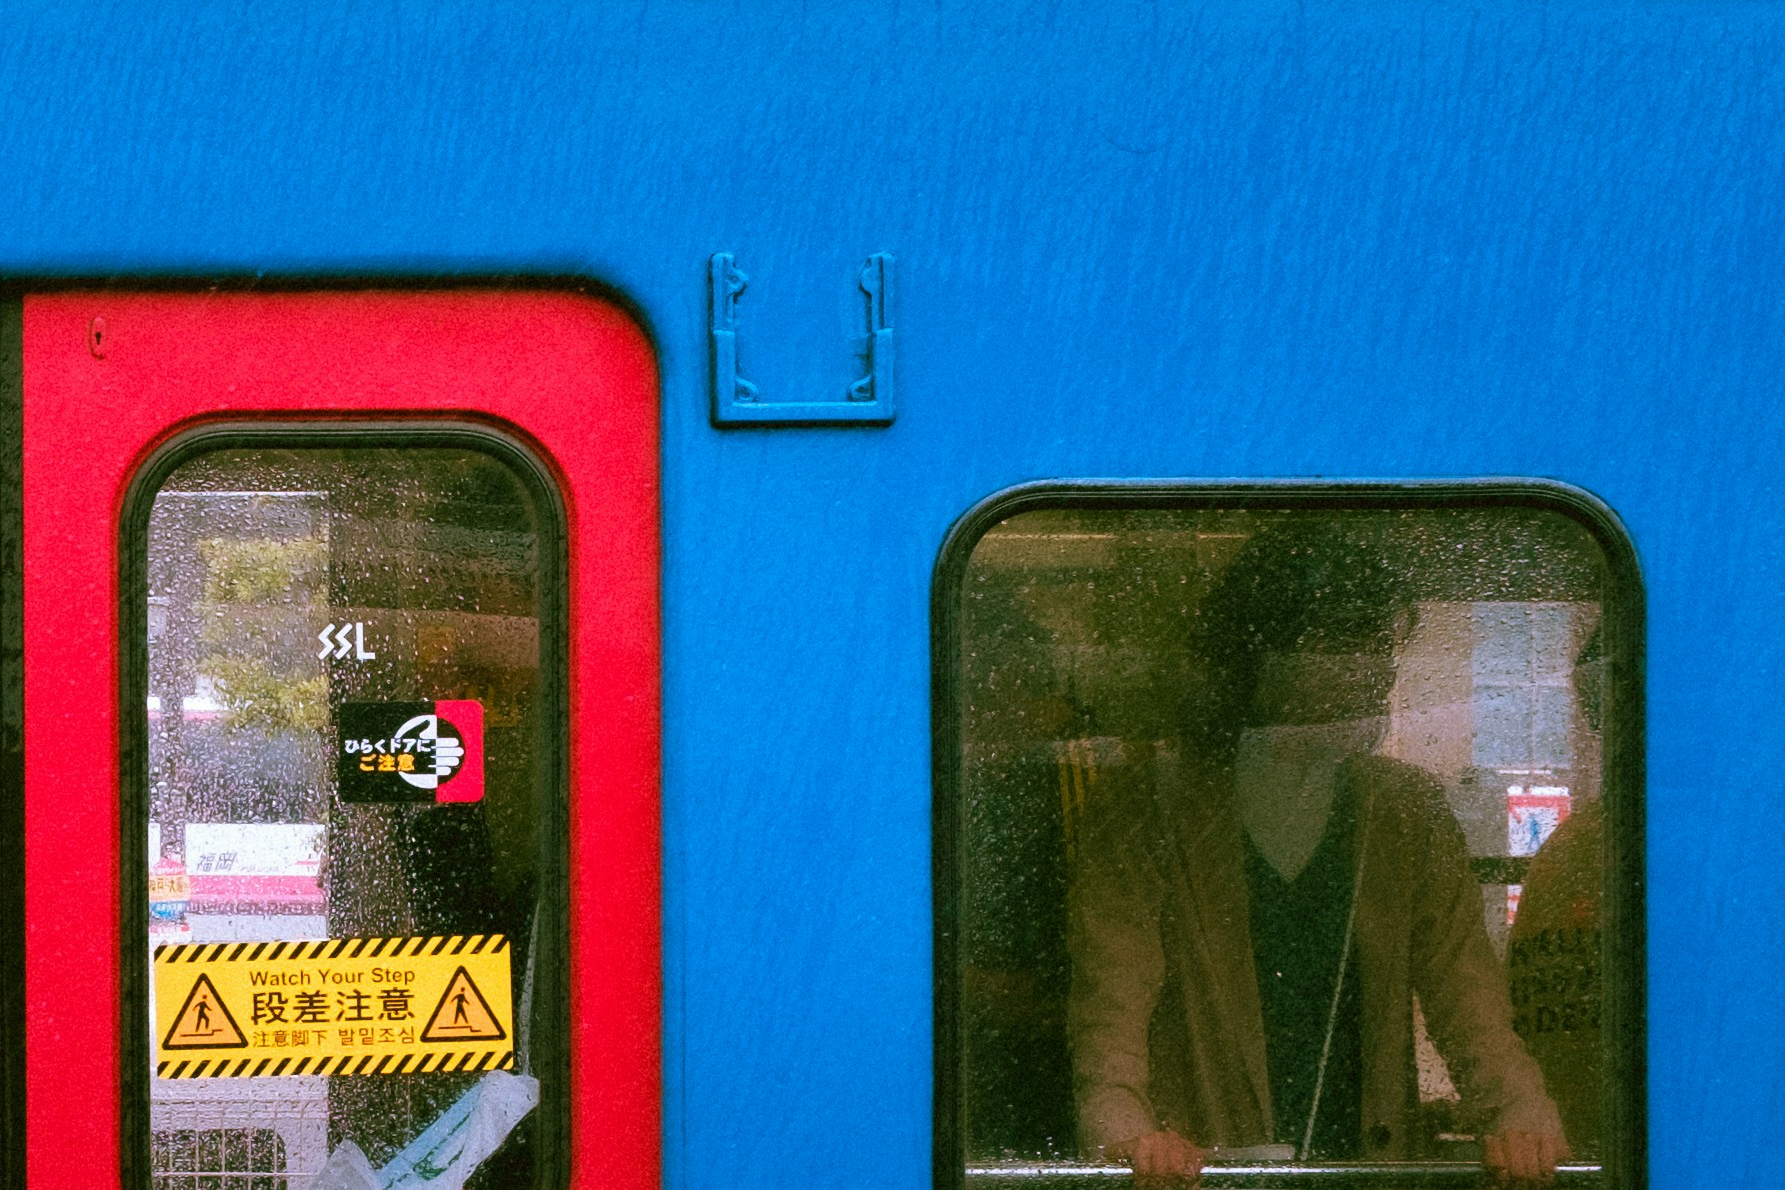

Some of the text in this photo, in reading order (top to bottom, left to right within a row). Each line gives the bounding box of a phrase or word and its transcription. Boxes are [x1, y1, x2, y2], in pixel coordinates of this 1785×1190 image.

[317, 621, 376, 661] SSL
[344, 738, 432, 754] ひらくドアに
[359, 753, 415, 772] ご注意
[249, 967, 415, 986] Watch Your Step
[251, 988, 415, 1025] 段差注意
[252, 1026, 416, 1048] 注意脚下 발밑조심
